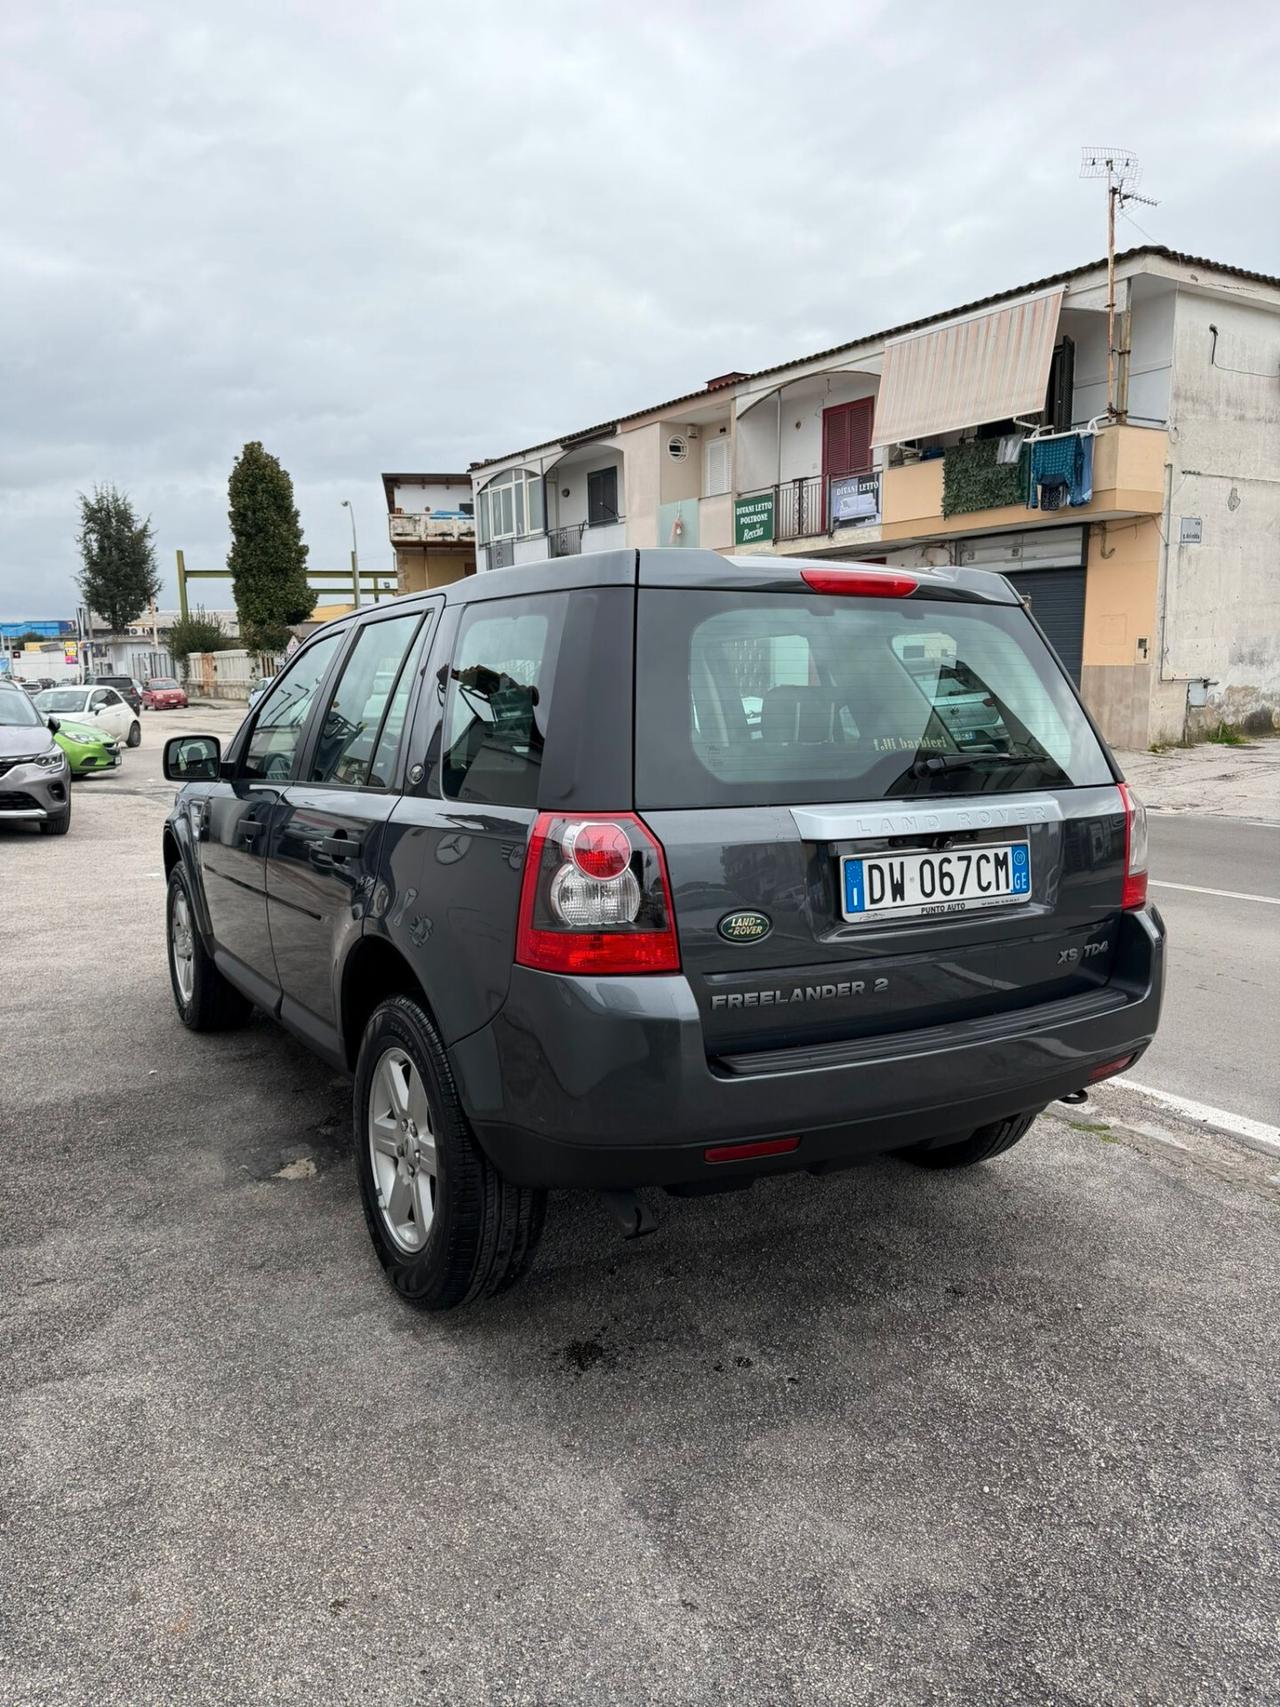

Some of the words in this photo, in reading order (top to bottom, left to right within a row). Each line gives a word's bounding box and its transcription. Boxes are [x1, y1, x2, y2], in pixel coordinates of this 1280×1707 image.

[836, 485, 858, 496] DIVANI
[859, 481, 879, 492] LETTO
[736, 505, 755, 515] DIVANI
[755, 502, 772, 512] LETTO
[740, 513, 768, 525] POLTRONE
[856, 814, 942, 834] LAND
[957, 806, 1049, 826] ROVER
[868, 861, 905, 906] DW
[919, 851, 1010, 898] 067CM
[1014, 872, 1027, 889] GE
[921, 905, 944, 914] PUNTO
[946, 902, 966, 911] AUTO
[1057, 948, 1078, 964] XS
[711, 980, 866, 1010] FREELANDER
[873, 977, 889, 992] 2
